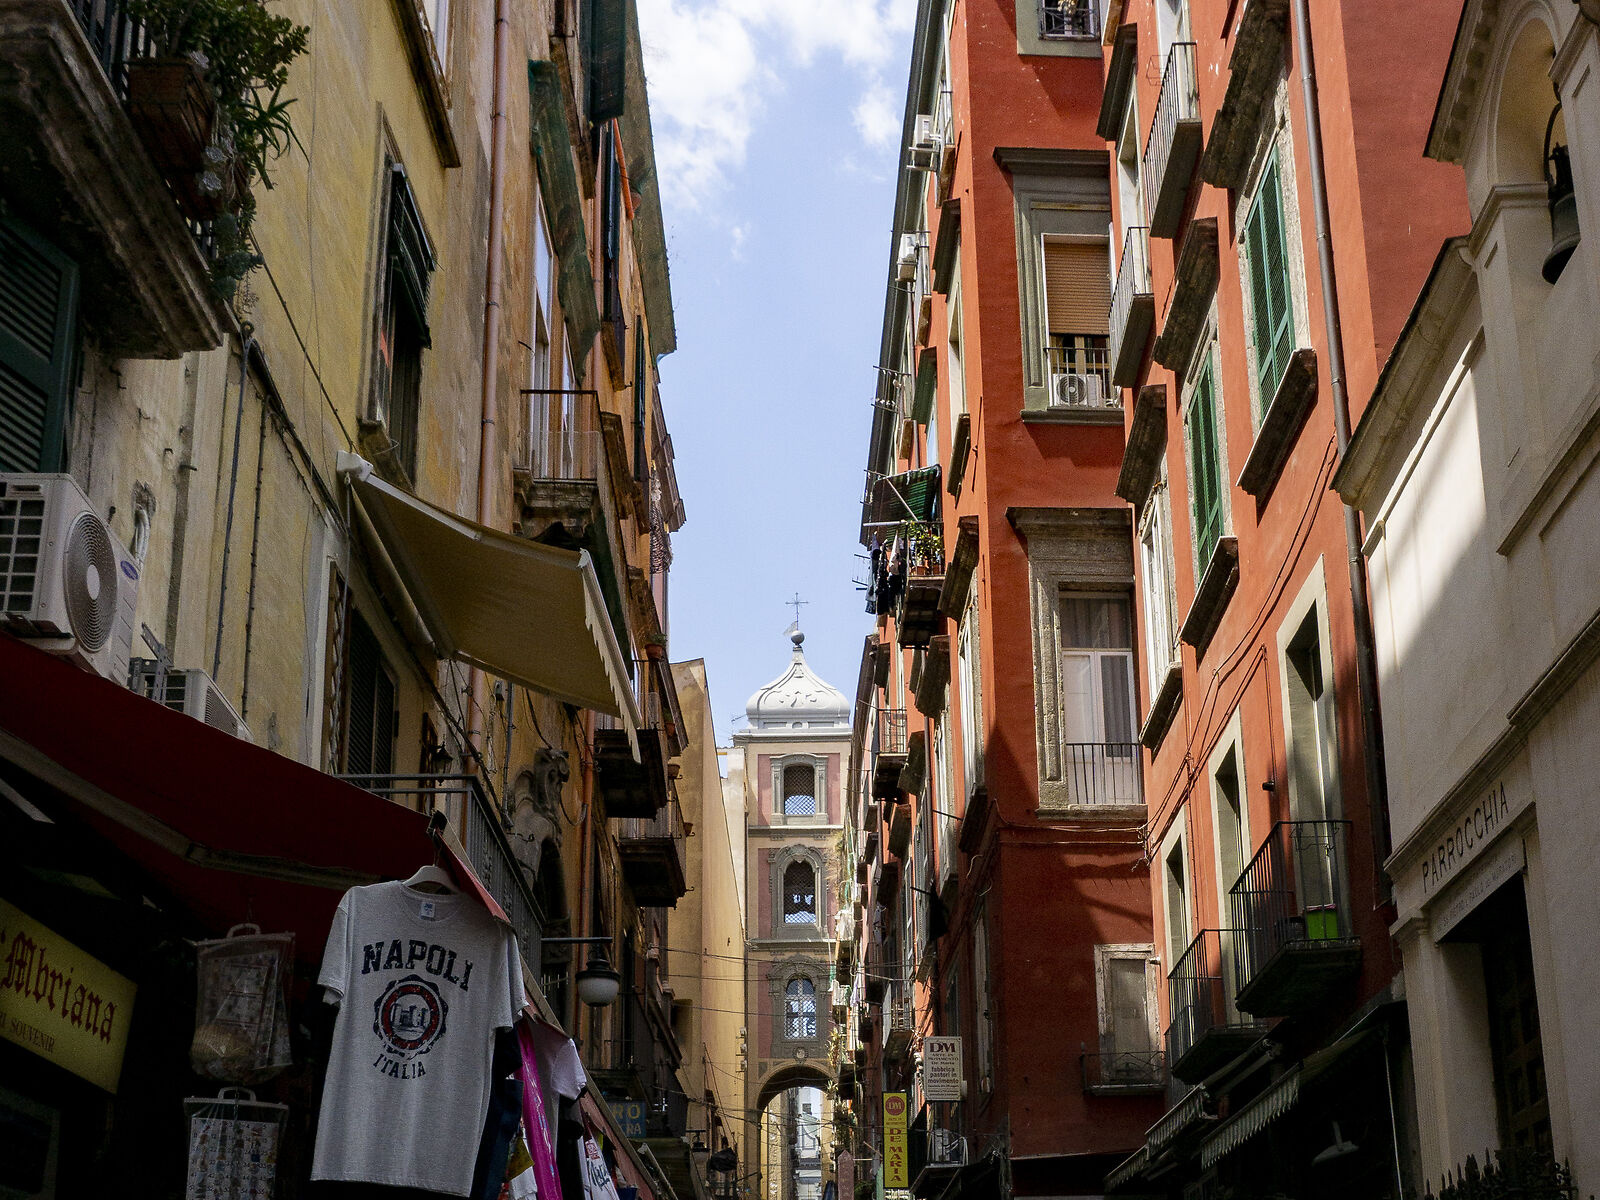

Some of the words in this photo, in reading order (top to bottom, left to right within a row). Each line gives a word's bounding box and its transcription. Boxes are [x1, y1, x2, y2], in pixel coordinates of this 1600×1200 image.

[1421, 781, 1509, 894] PARROCCHIA
[361, 939, 473, 992] NAPOLI
[11, 1018, 56, 1053] SOUVENIR
[929, 1042, 956, 1053] DM
[373, 1054, 426, 1080] ITALIA
[611, 1103, 641, 1119] RO
[888, 1102, 902, 1110] DM
[889, 1146, 903, 1182] MARIA
